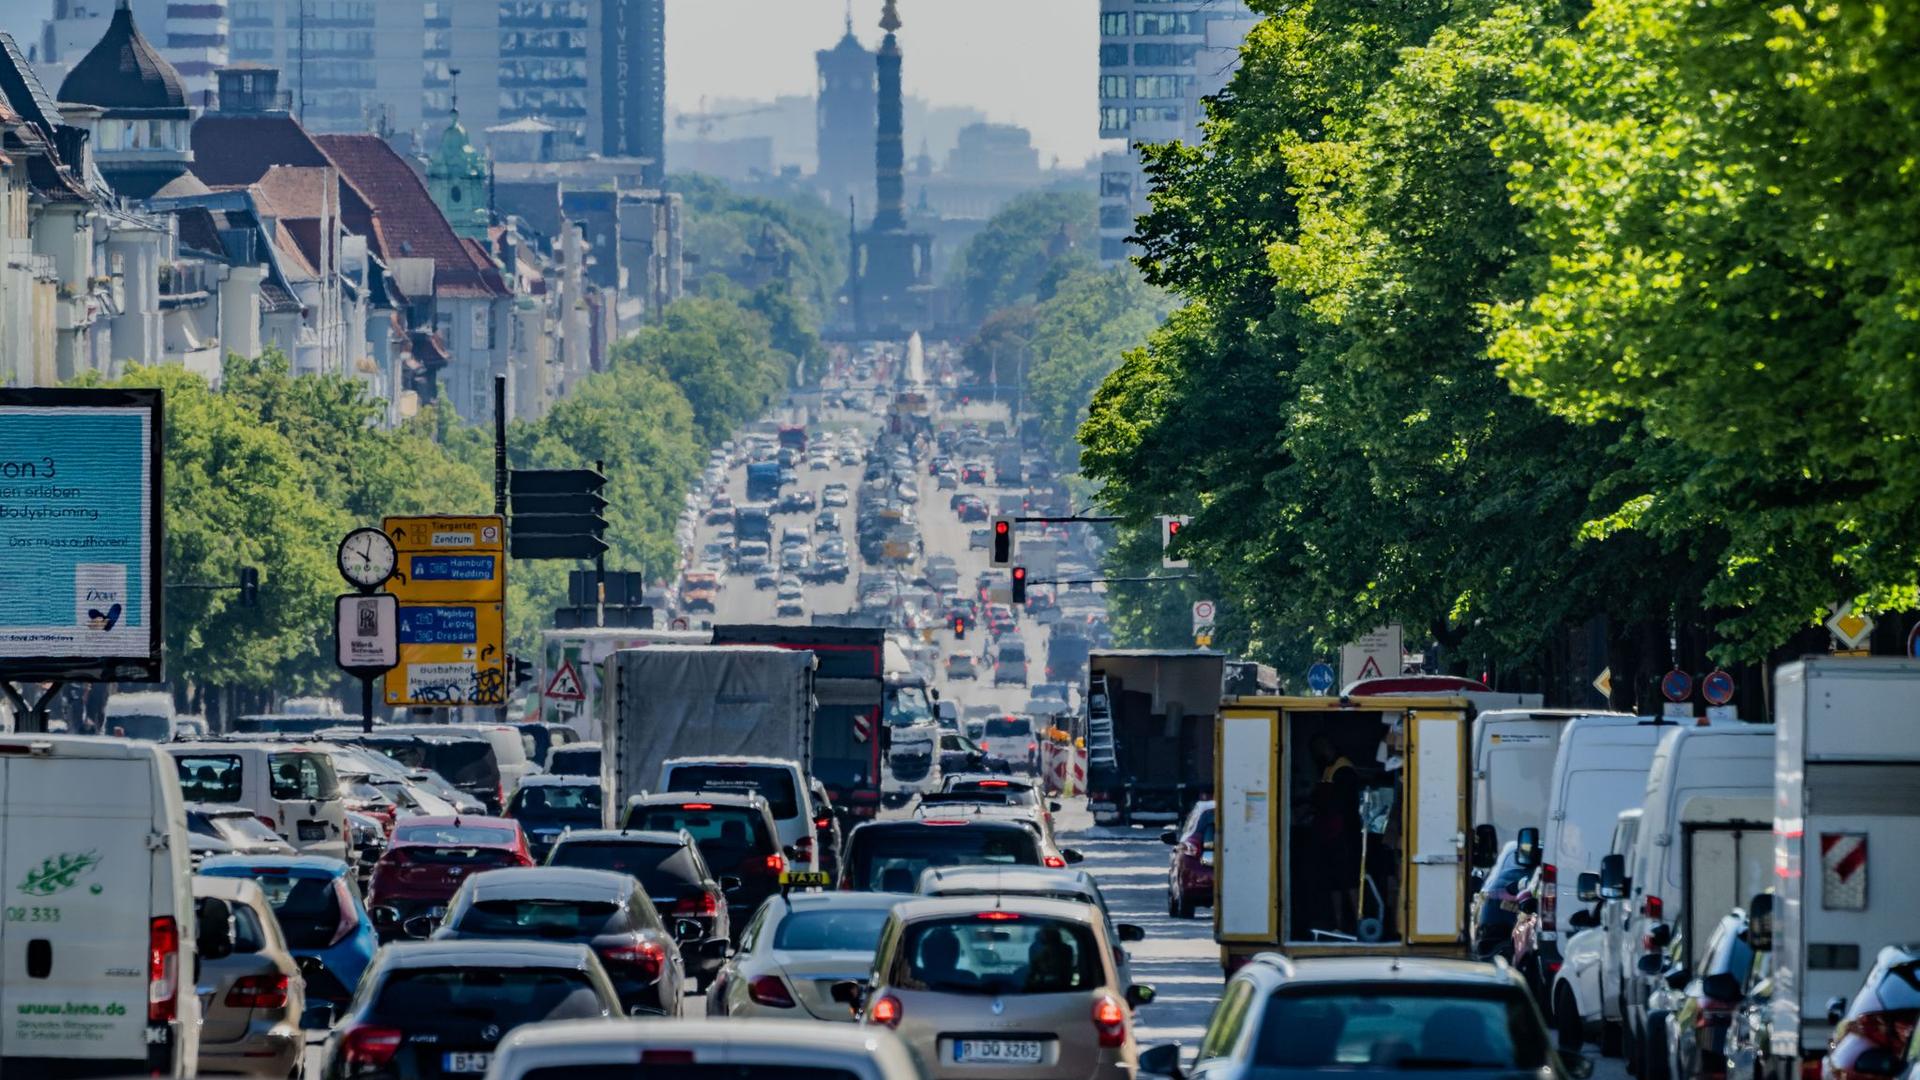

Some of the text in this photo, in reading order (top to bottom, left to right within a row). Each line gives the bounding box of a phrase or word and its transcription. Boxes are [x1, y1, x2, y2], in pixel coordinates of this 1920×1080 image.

[0, 457, 56, 478] on 3
[25, 486, 80, 498] erleben
[432, 522, 478, 530] Tiergarten
[434, 535, 471, 544] Zentrum
[450, 559, 493, 568] Hamburg
[451, 571, 490, 579] Wedding
[443, 620, 474, 630] Leipzig
[437, 631, 474, 640] Dresden
[789, 872, 821, 882] TAXI
[31, 907, 61, 921] 333
